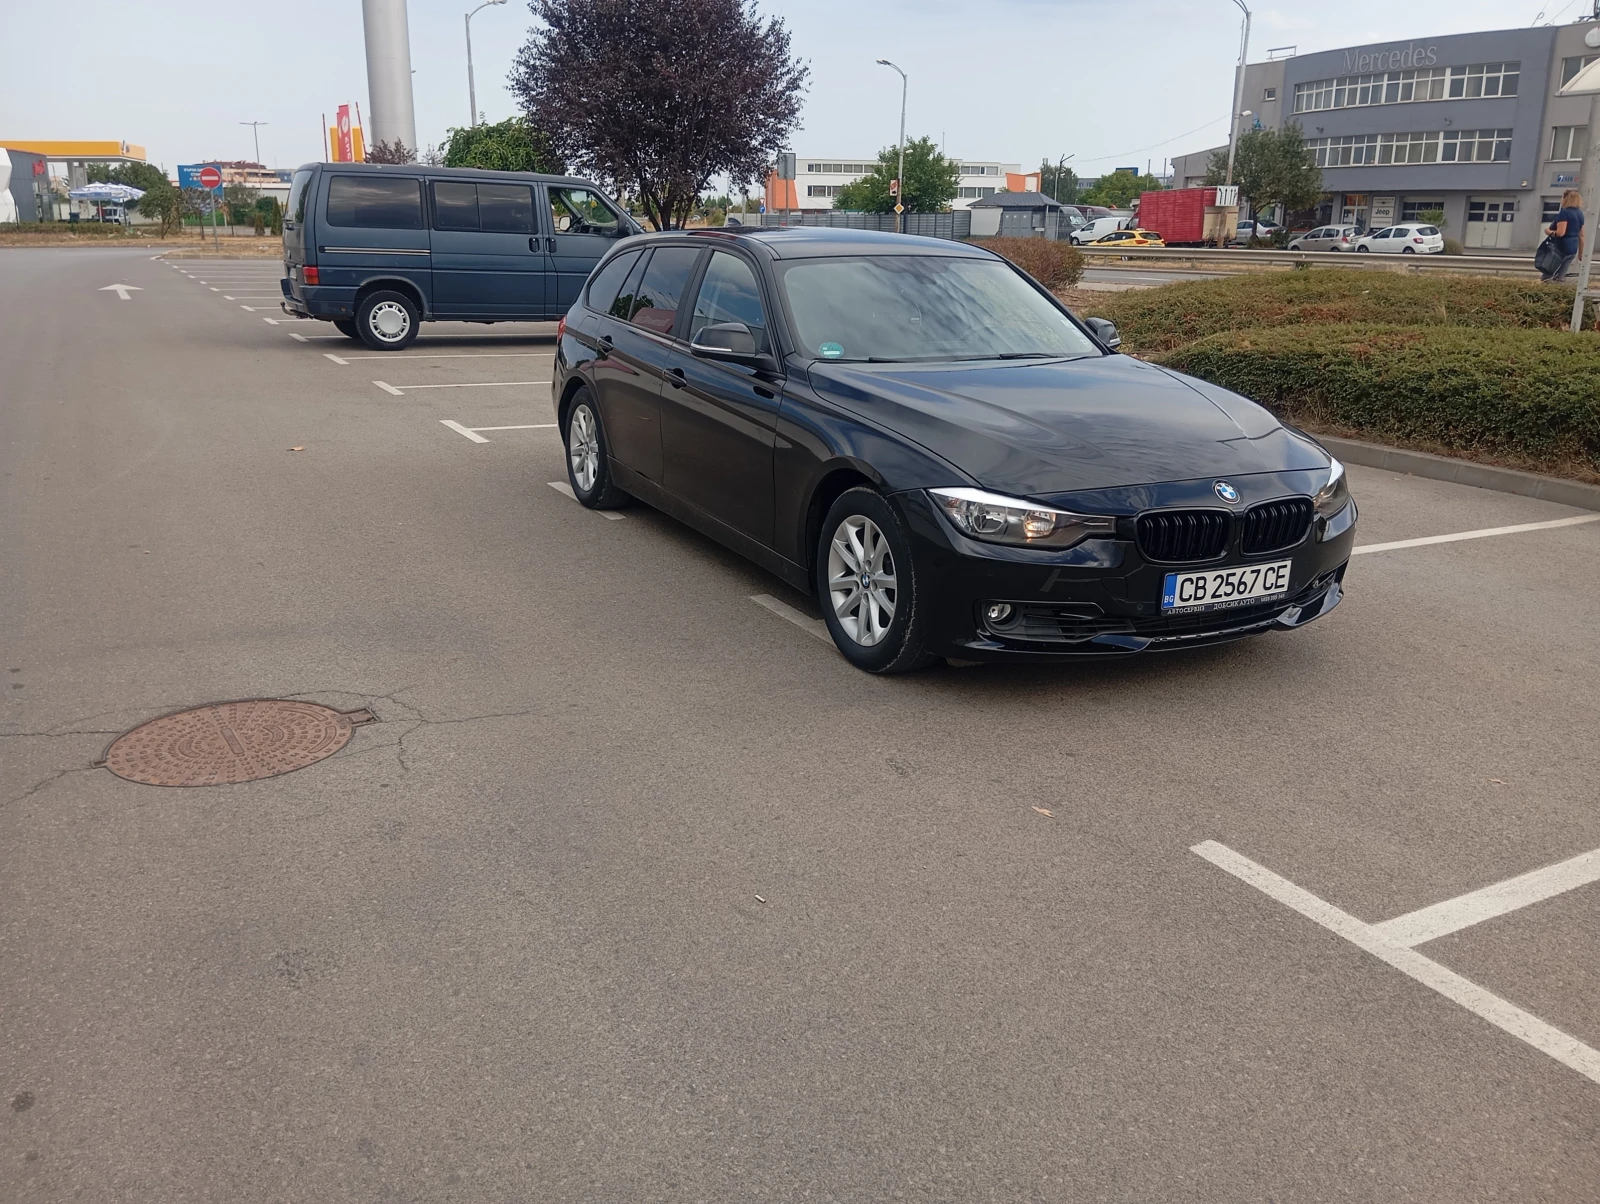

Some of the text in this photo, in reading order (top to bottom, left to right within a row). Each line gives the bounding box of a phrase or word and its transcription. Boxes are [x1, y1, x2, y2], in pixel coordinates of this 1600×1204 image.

[1342, 41, 1438, 75] Mercedes
[1164, 595, 1174, 603] BG
[1179, 564, 1288, 602] CB 2567 CE
